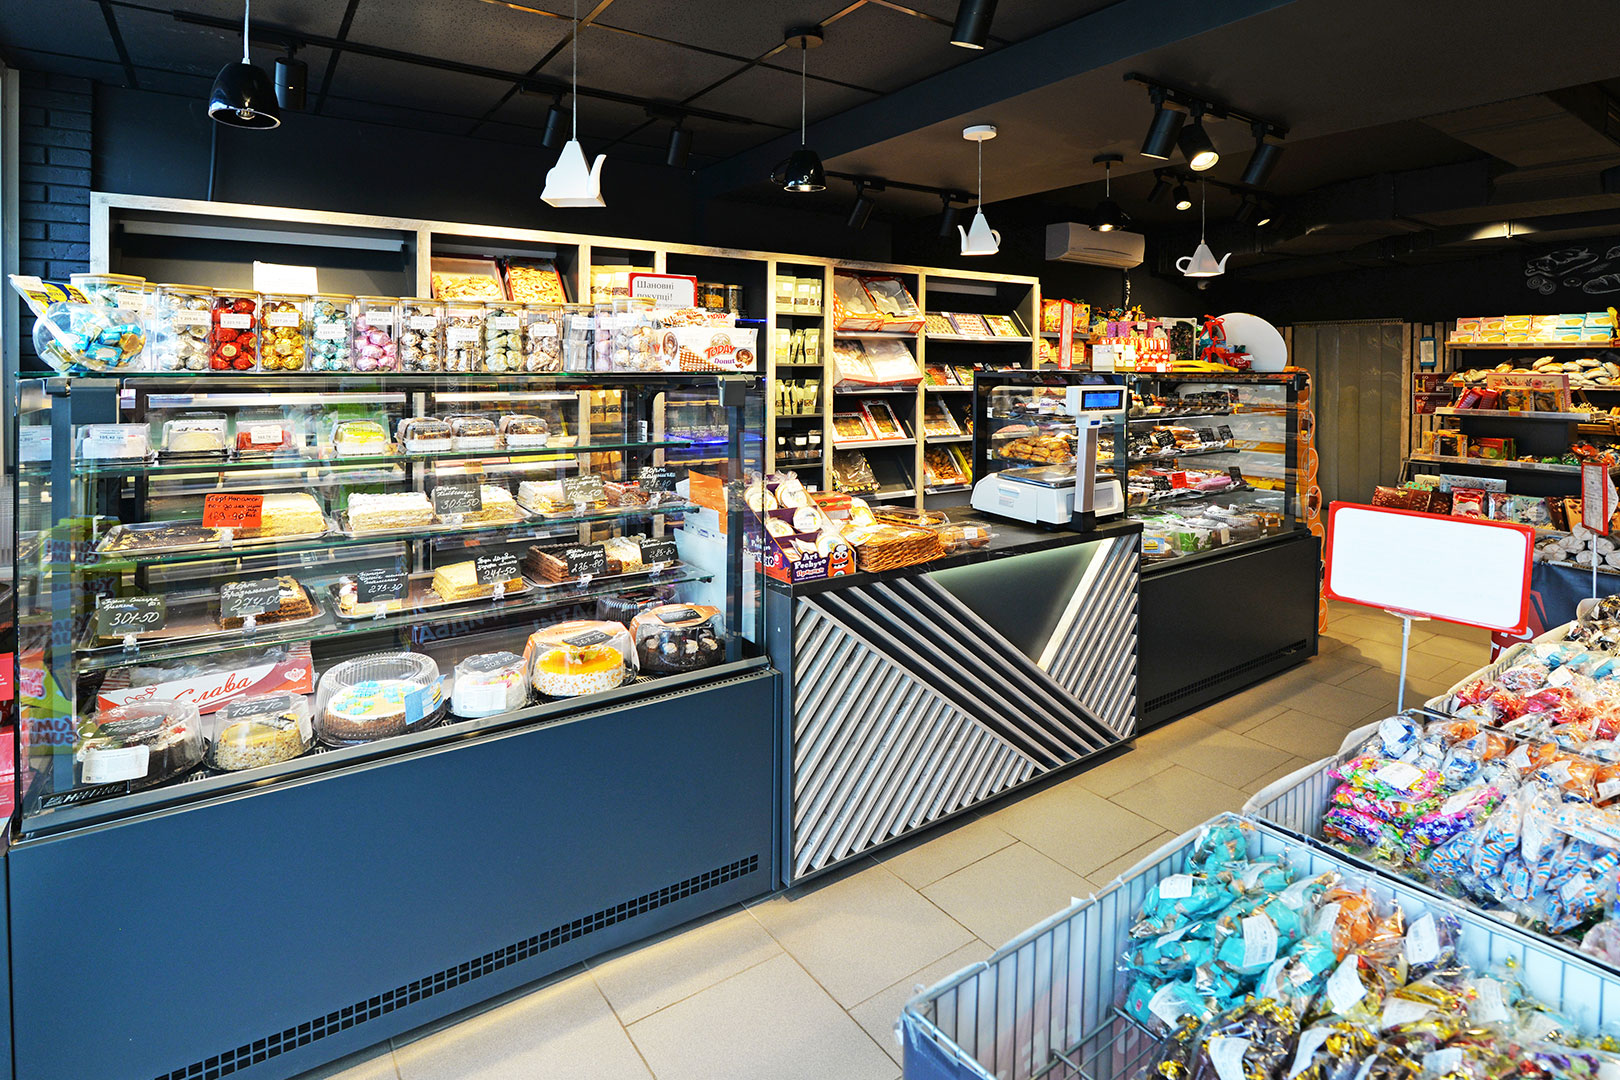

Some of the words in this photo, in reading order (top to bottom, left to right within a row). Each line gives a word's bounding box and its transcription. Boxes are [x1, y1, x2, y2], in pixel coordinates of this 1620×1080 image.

[636, 280, 674, 290] Шановні
[704, 344, 736, 359] TODAY
[713, 357, 736, 365] Donut
[802, 552, 818, 562] Art
[173, 673, 252, 705] Слава
